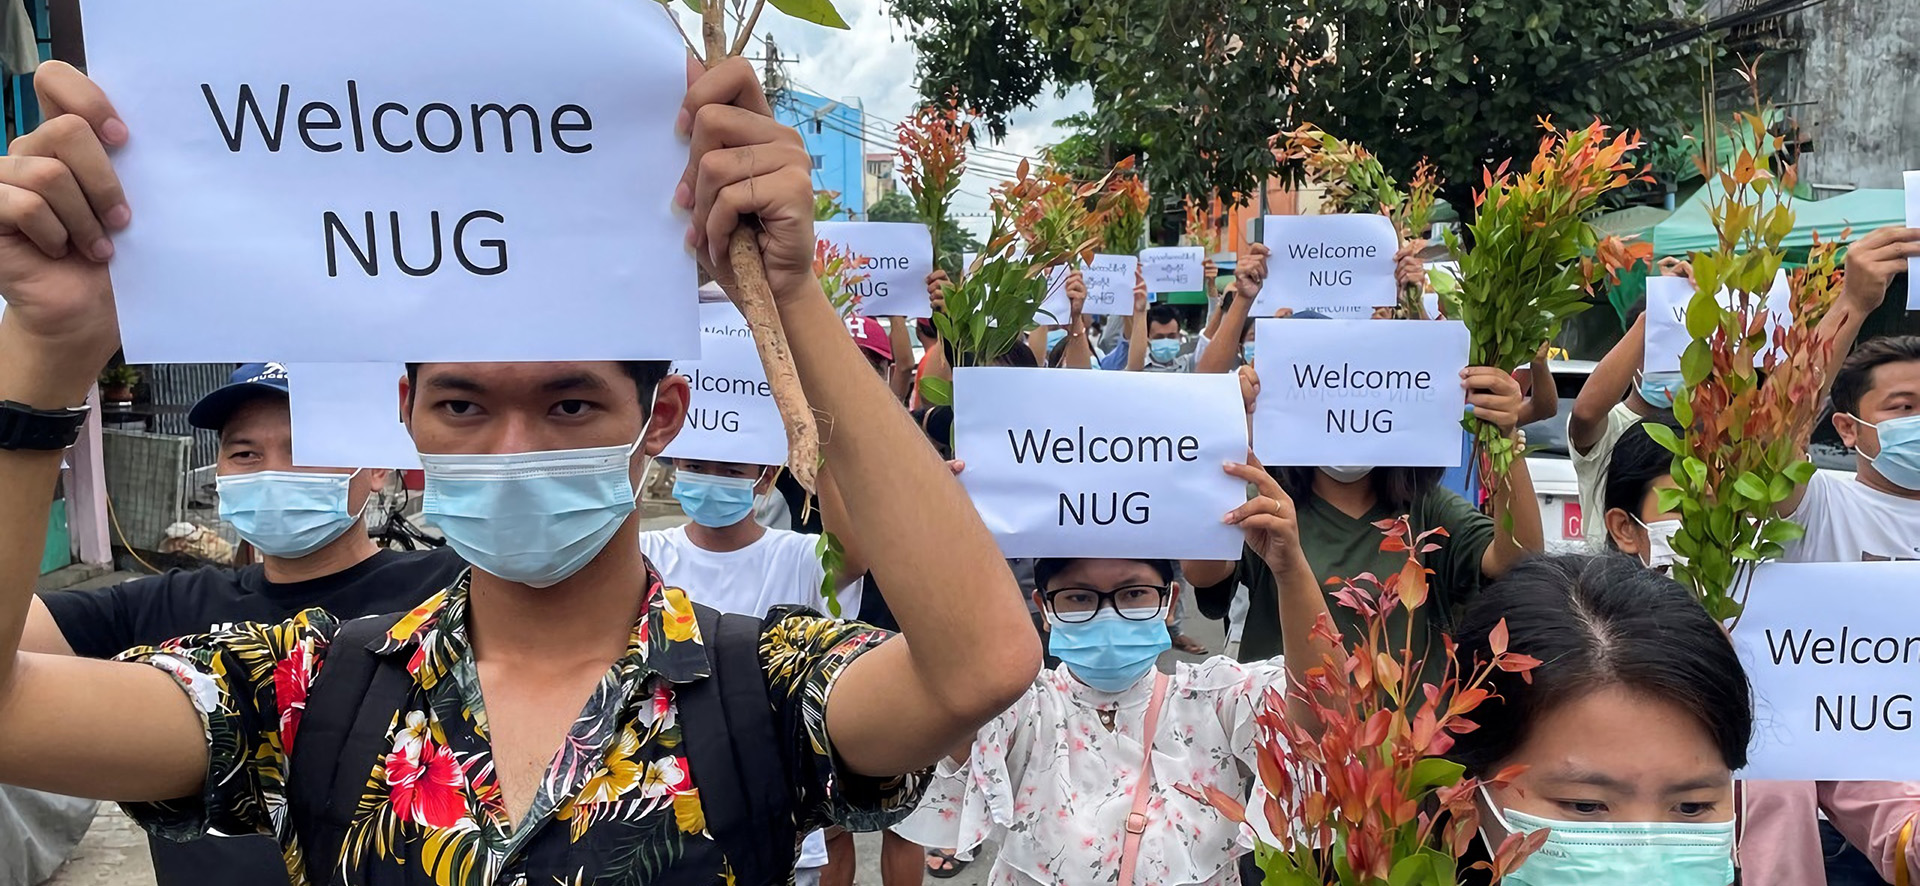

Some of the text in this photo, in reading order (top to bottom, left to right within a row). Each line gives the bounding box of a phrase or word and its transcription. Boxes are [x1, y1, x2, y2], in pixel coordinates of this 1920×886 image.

[200, 79, 593, 154] Welcome
[323, 209, 509, 278] NUG
[1288, 242, 1377, 259] Welcome
[1309, 270, 1352, 287] NUG
[675, 368, 771, 397] elcome
[1293, 363, 1431, 389] Welcome
[1327, 409, 1393, 433] NUG
[1008, 426, 1199, 464] Welcome
[1058, 491, 1150, 526] NUG
[1815, 694, 1913, 732] NUG
